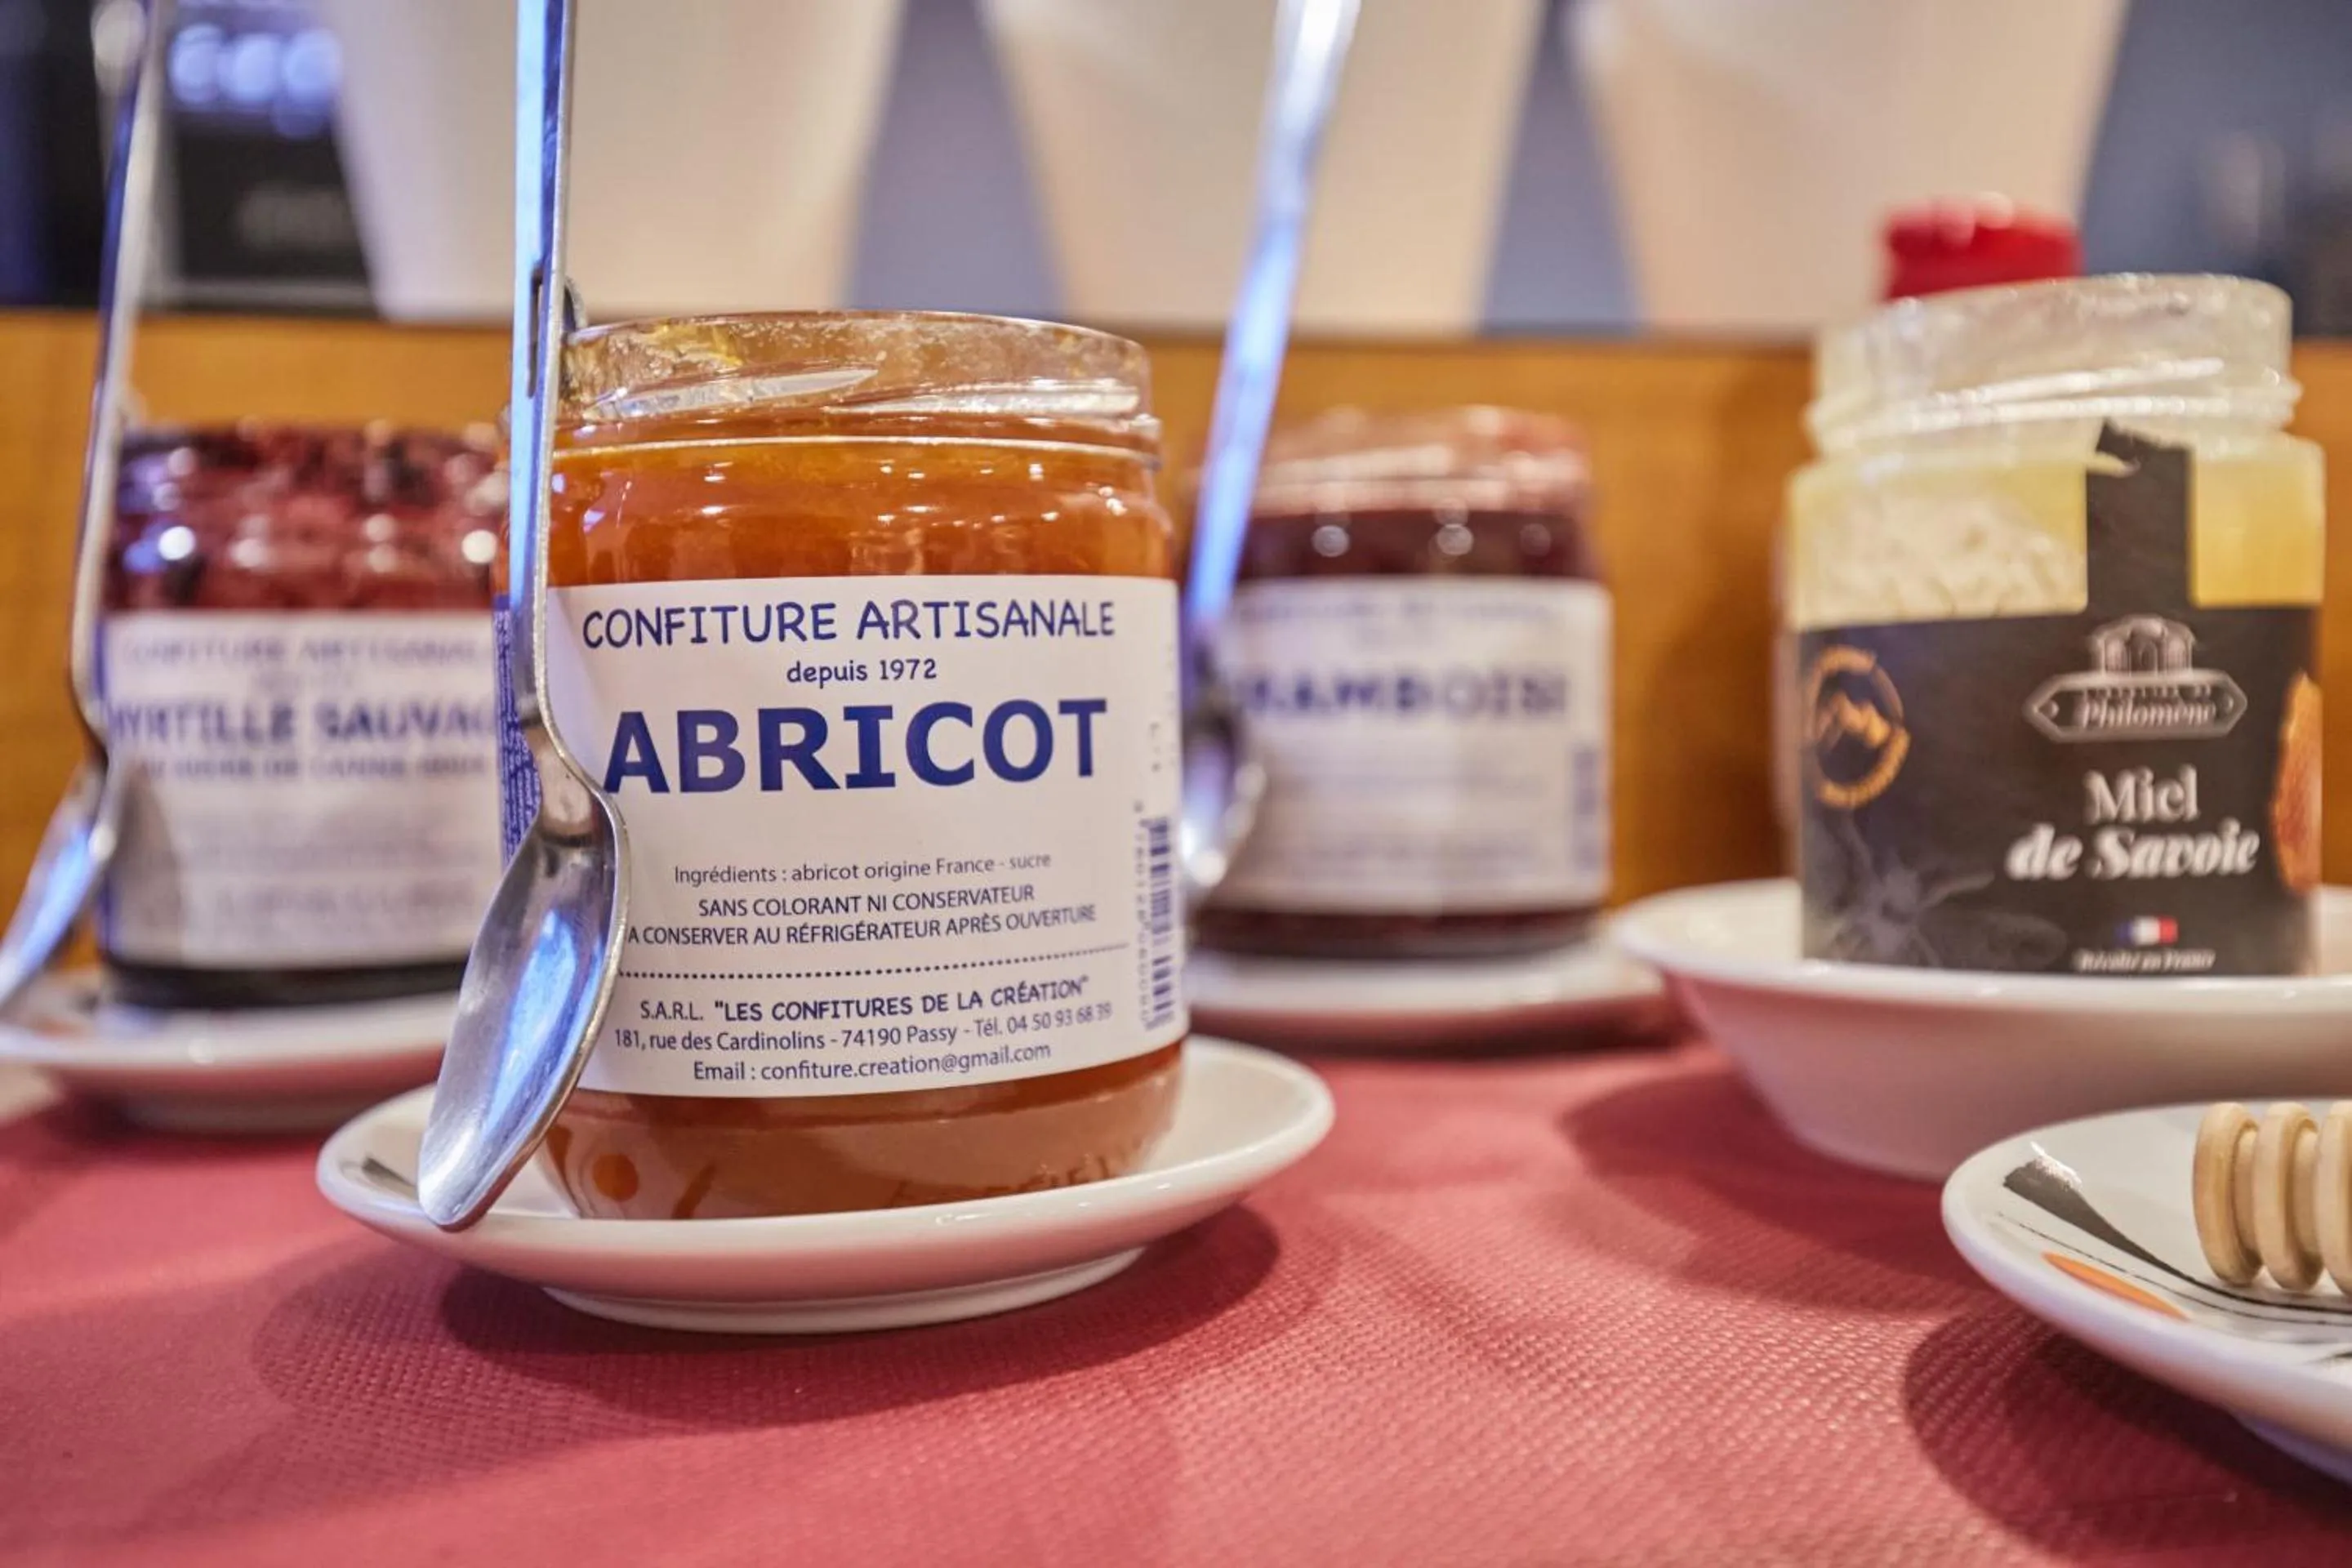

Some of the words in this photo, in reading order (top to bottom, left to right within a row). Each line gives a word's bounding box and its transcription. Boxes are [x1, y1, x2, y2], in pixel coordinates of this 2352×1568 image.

[583, 602, 837, 649] CONFITURE
[857, 599, 1116, 640] ARTISANALE
[786, 660, 867, 688] depuis
[880, 658, 937, 680] 1972
[603, 698, 1107, 793] ABRICOT
[2086, 763, 2200, 825] Miel
[675, 866, 777, 888] Ingrédients
[792, 864, 858, 882] abricot
[864, 860, 931, 882] origine
[936, 858, 995, 875] France
[1009, 853, 1052, 871] sucre
[2005, 822, 2082, 880] de
[2084, 817, 2261, 880] Savoie
[699, 899, 747, 917] SANS
[753, 896, 862, 916] COLORANT
[867, 893, 887, 913] NI
[893, 884, 1036, 911] CONSERVATEUR
[627, 927, 641, 945] A
[643, 926, 749, 945] CONSERVER
[754, 926, 781, 945] AU
[786, 917, 941, 944] RÉFRIGÉRATEUR
[945, 912, 1002, 937] APRÈS
[1006, 904, 1097, 931] OUVERTURE
[640, 1000, 704, 1021] S.A.R.L.
[715, 1000, 764, 1022] "LES
[772, 996, 913, 1021] CONFITURES
[922, 993, 949, 1014] DE
[957, 991, 983, 1011] LA
[991, 975, 1089, 1007] CRÉATION"
[614, 1029, 646, 1051] 181,
[649, 1035, 677, 1051] rue
[681, 1031, 712, 1051] des
[716, 1031, 826, 1052] Cardinolins
[841, 1027, 902, 1049] 74190
[907, 1025, 958, 1045] Passy
[974, 1018, 1003, 1038] Tél.
[1007, 1015, 1028, 1034] 04
[1032, 1011, 1052, 1031] 50
[1054, 1008, 1073, 1027] 93
[694, 1061, 745, 1080] Email
[761, 1043, 1052, 1081] confiture.creation@gmail.com
